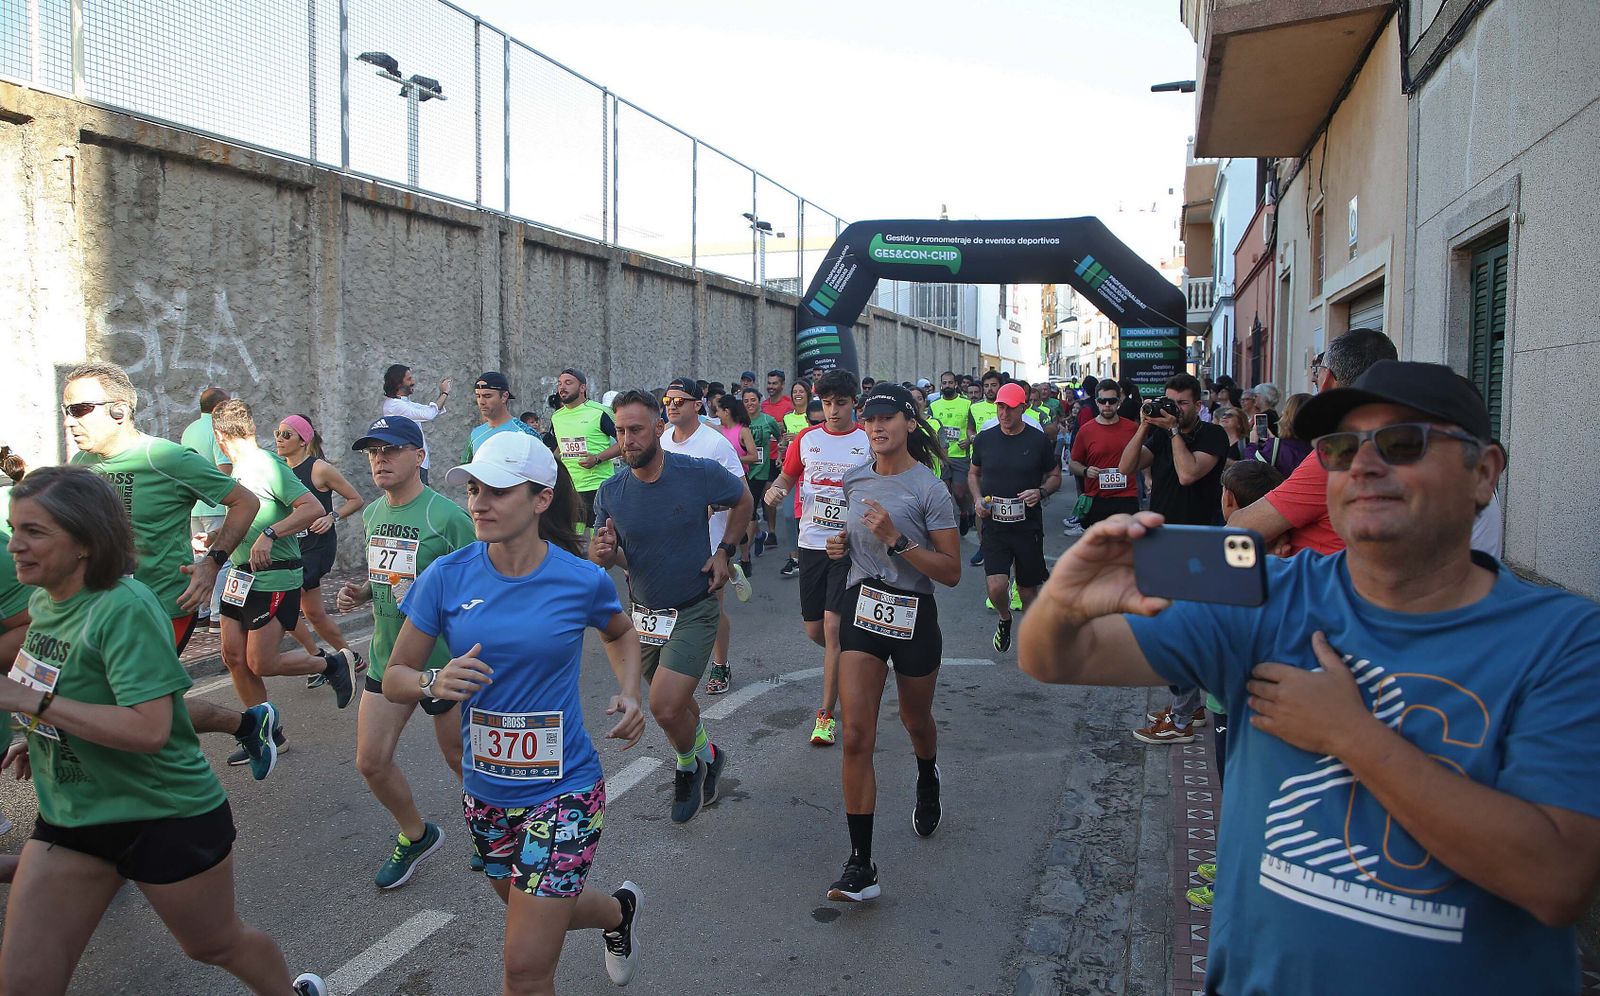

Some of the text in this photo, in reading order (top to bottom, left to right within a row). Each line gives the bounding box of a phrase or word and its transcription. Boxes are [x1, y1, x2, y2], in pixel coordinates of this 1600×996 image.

[885, 234, 1060, 246] Gestión y cronometraje de eventos deportivos
[874, 248, 958, 261] GES&CON-CHIP
[565, 442, 580, 452] 369
[1104, 473, 1121, 483] 365
[825, 505, 840, 520] 62
[1001, 504, 1012, 515] 61
[380, 523, 420, 540] CROSS
[379, 549, 398, 570] 27
[873, 603, 895, 624] 63
[641, 616, 657, 632] 53
[29, 632, 71, 663] CROSS
[502, 716, 526, 729] CROSS
[487, 729, 538, 760] 370
[1302, 867, 1316, 883] IT
[1364, 887, 1397, 906] THE
[1410, 897, 1465, 920] LIMIT
